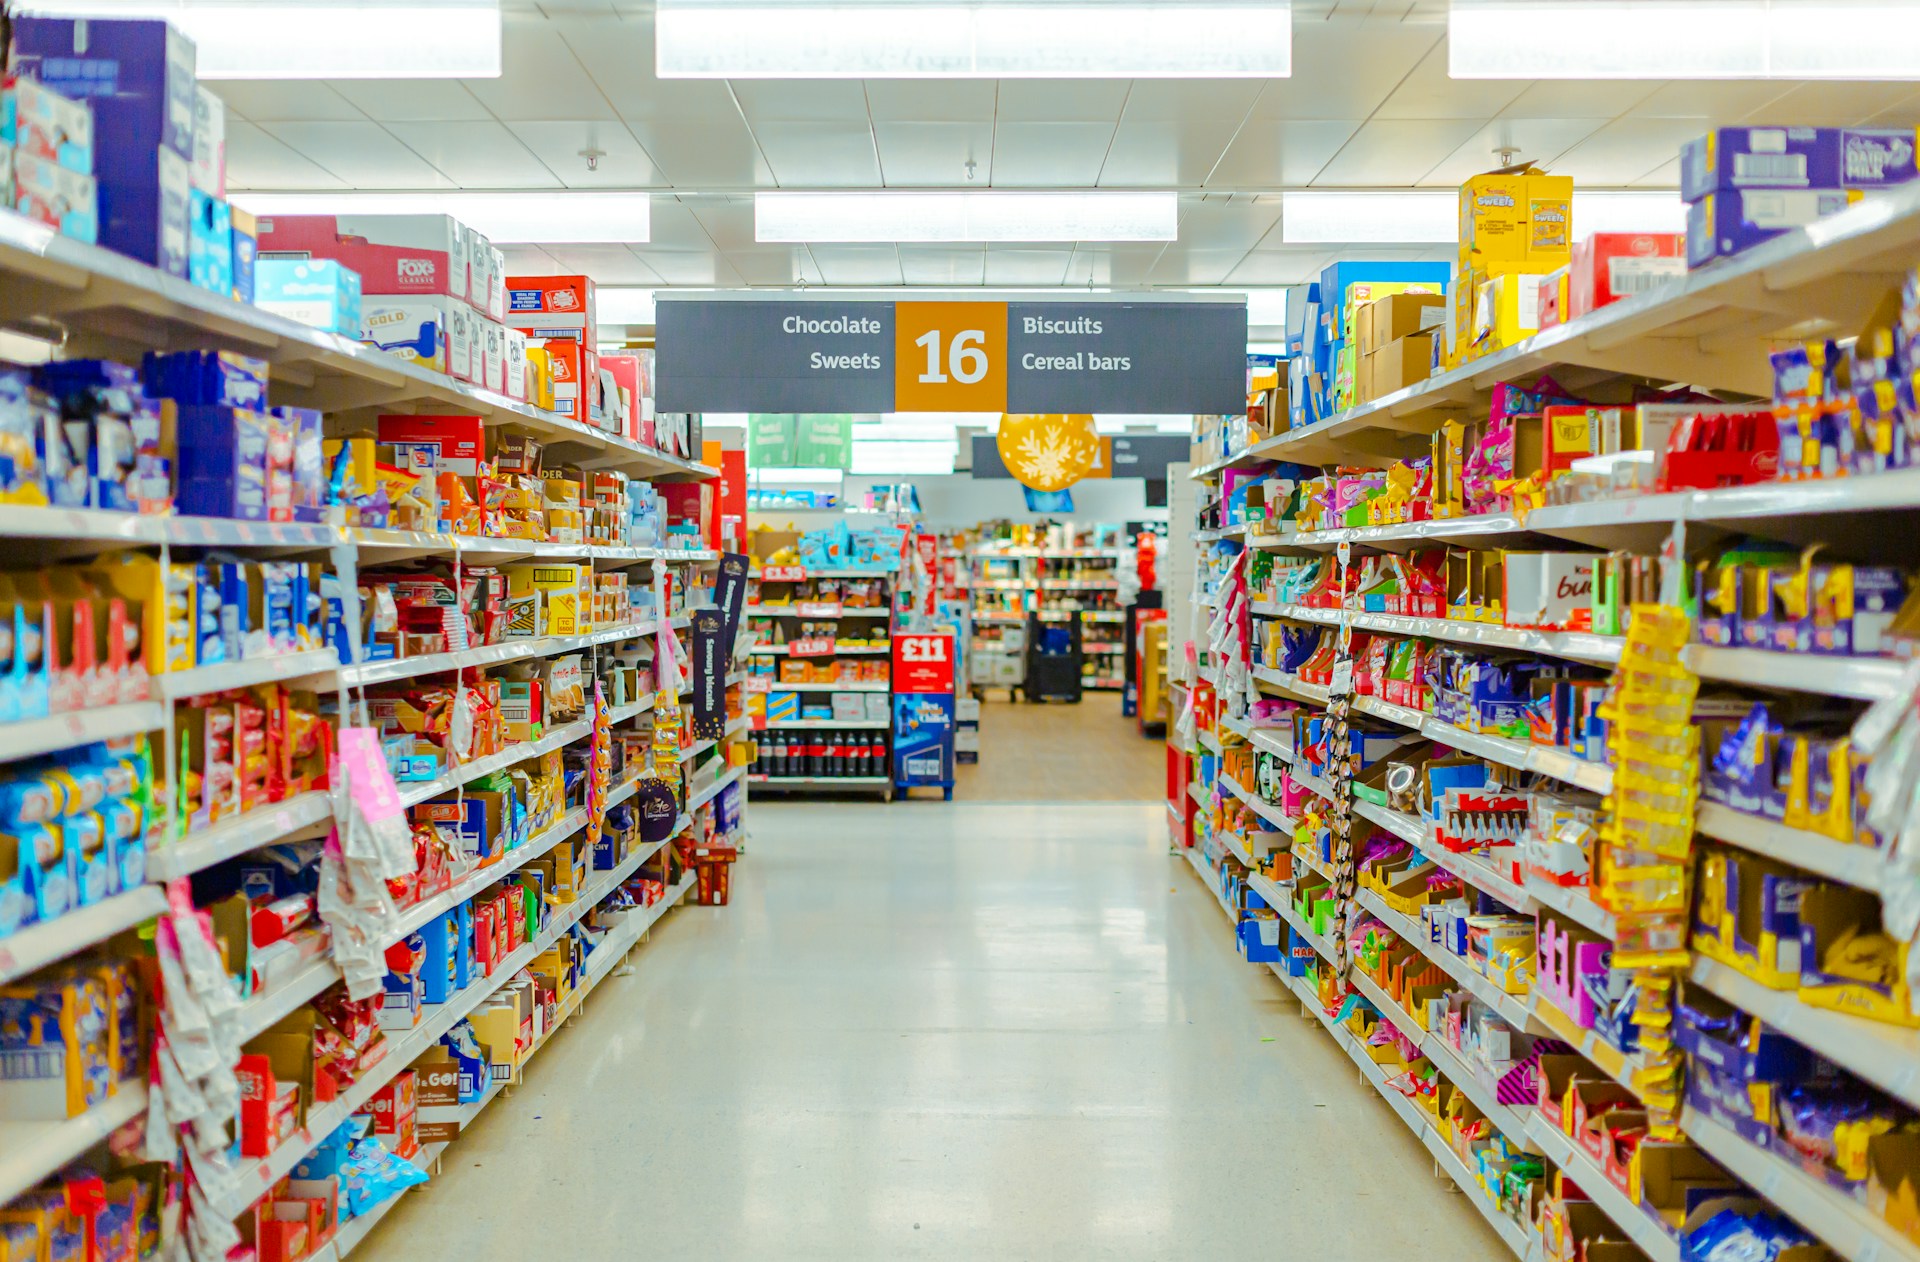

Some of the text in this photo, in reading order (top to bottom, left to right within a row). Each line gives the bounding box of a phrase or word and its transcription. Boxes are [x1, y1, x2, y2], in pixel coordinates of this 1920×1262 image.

[1477, 195, 1515, 207] SWEETS
[1534, 213, 1565, 222] SWEETS
[368, 311, 405, 327] GOLD
[782, 315, 881, 334] Chocolate
[1022, 315, 1103, 335] Biscuits
[810, 351, 881, 370] Sweets
[915, 329, 989, 384] 16
[1021, 352, 1131, 371] Cereal bars
[722, 580, 737, 613] Savoury
[703, 638, 715, 675] Savoury
[901, 637, 947, 662] £11
[705, 676, 715, 712] biscuits
[431, 807, 450, 817] CLUB
[1293, 947, 1315, 958] HAR
[428, 1072, 458, 1087] GO!
[363, 1099, 393, 1113] GO!
